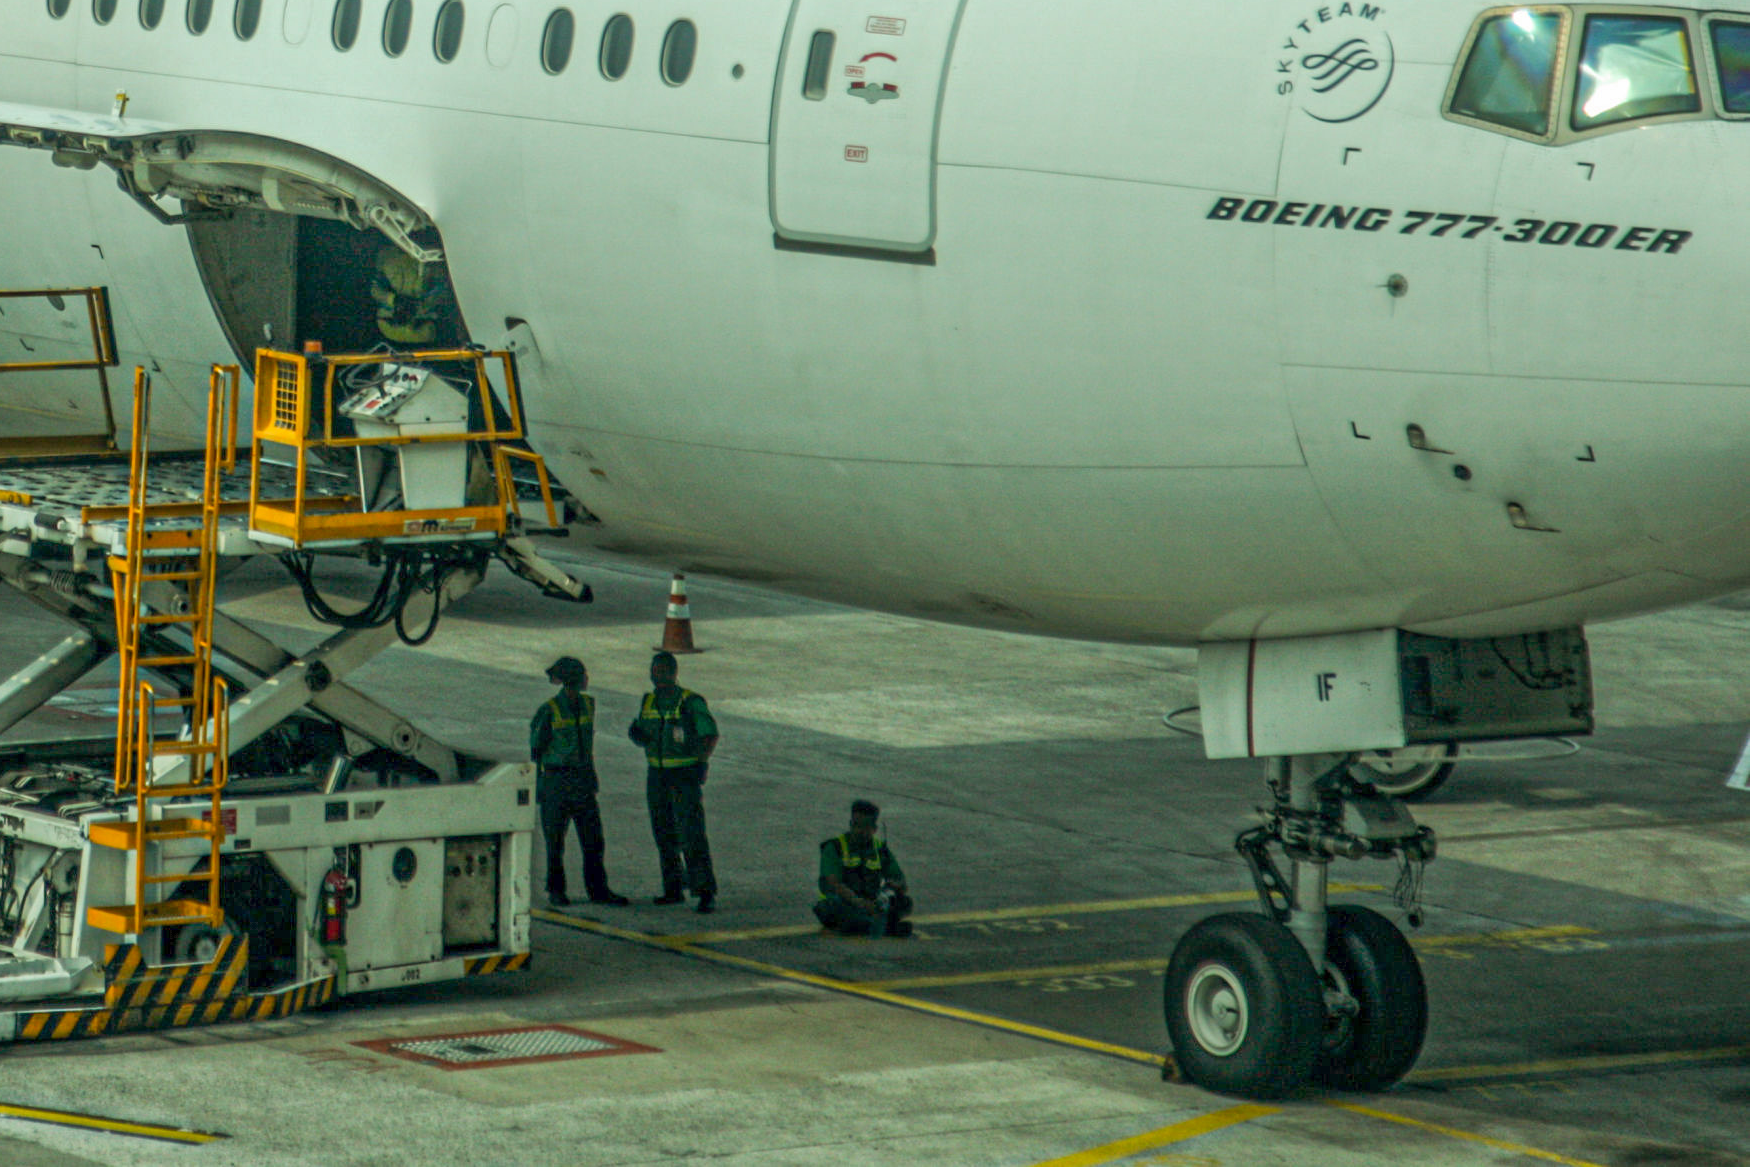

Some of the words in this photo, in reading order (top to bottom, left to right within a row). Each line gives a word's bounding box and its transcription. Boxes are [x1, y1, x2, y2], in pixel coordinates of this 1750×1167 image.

[1277, 1, 1381, 96] SKYTEAM
[847, 148, 865, 159] EXIT
[1206, 197, 1392, 232] BOEING
